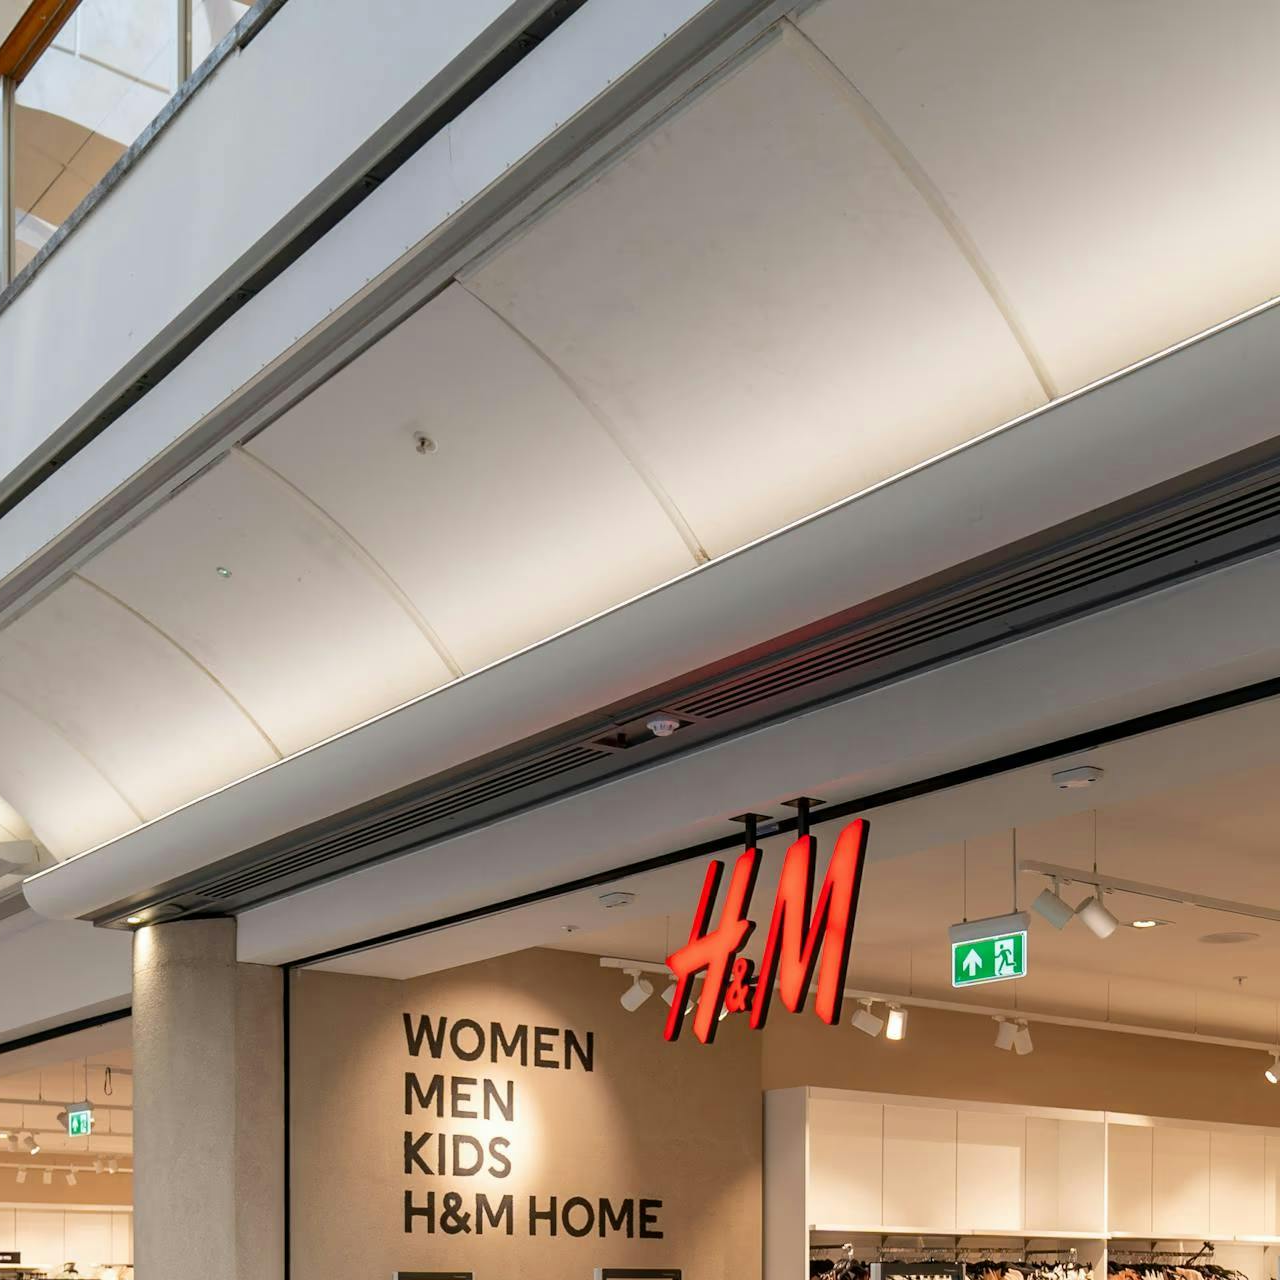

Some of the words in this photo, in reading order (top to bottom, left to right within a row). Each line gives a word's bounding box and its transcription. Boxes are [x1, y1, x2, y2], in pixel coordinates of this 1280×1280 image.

[664, 818, 870, 1044] H&M
[403, 1013, 595, 1072] WOMEN
[404, 1073, 514, 1122] MEN
[404, 1131, 512, 1179] KIDS
[404, 1190, 513, 1235] H&M
[528, 1196, 664, 1239] HOME
